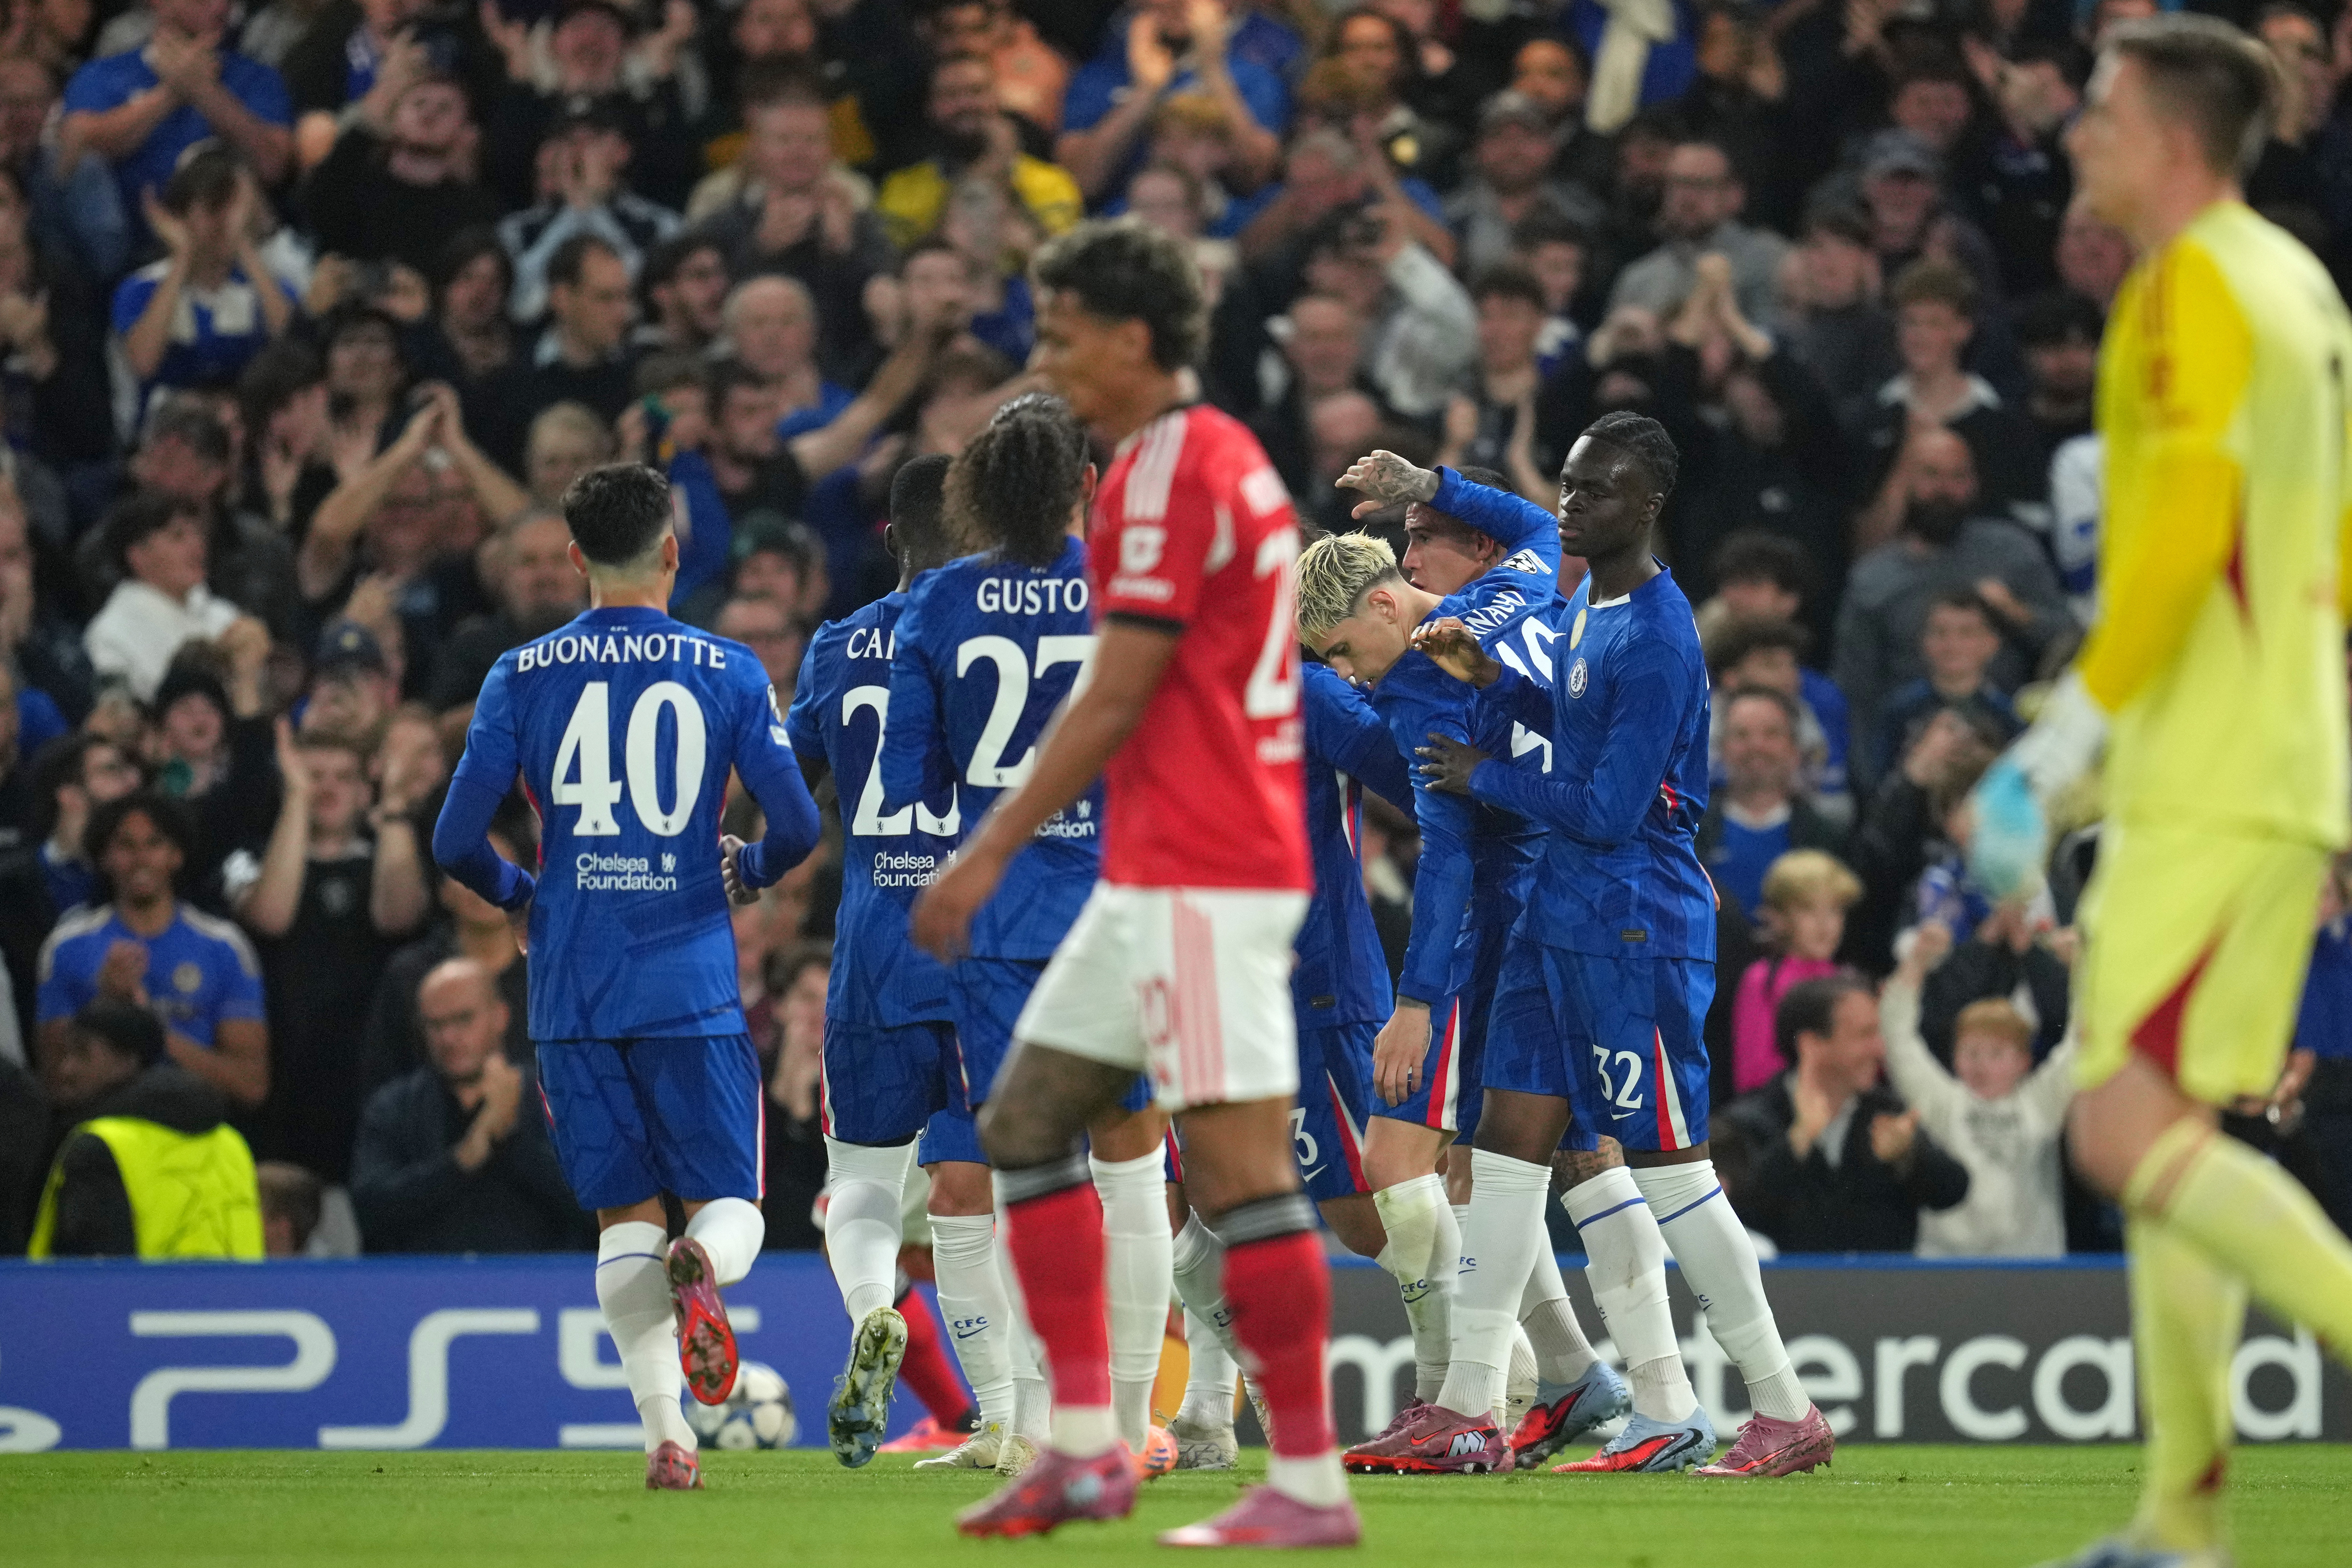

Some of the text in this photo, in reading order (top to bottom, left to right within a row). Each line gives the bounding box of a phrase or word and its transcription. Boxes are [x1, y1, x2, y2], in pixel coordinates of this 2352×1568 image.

[977, 577, 1089, 615] GUSTO
[518, 633, 726, 673] BUONANOTTE
[956, 635, 1100, 788] 27
[551, 680, 706, 836] 40
[576, 852, 649, 872] Chelsea
[874, 851, 934, 870] Chelsea
[577, 871, 677, 891] Foundation
[873, 868, 940, 887] Foundati
[1592, 1043, 1643, 1109] 32
[1289, 1107, 1318, 1166] 3
[1460, 1256, 1477, 1266] FC
[1401, 1279, 1428, 1293] CFC
[954, 1316, 987, 1329] CFC
